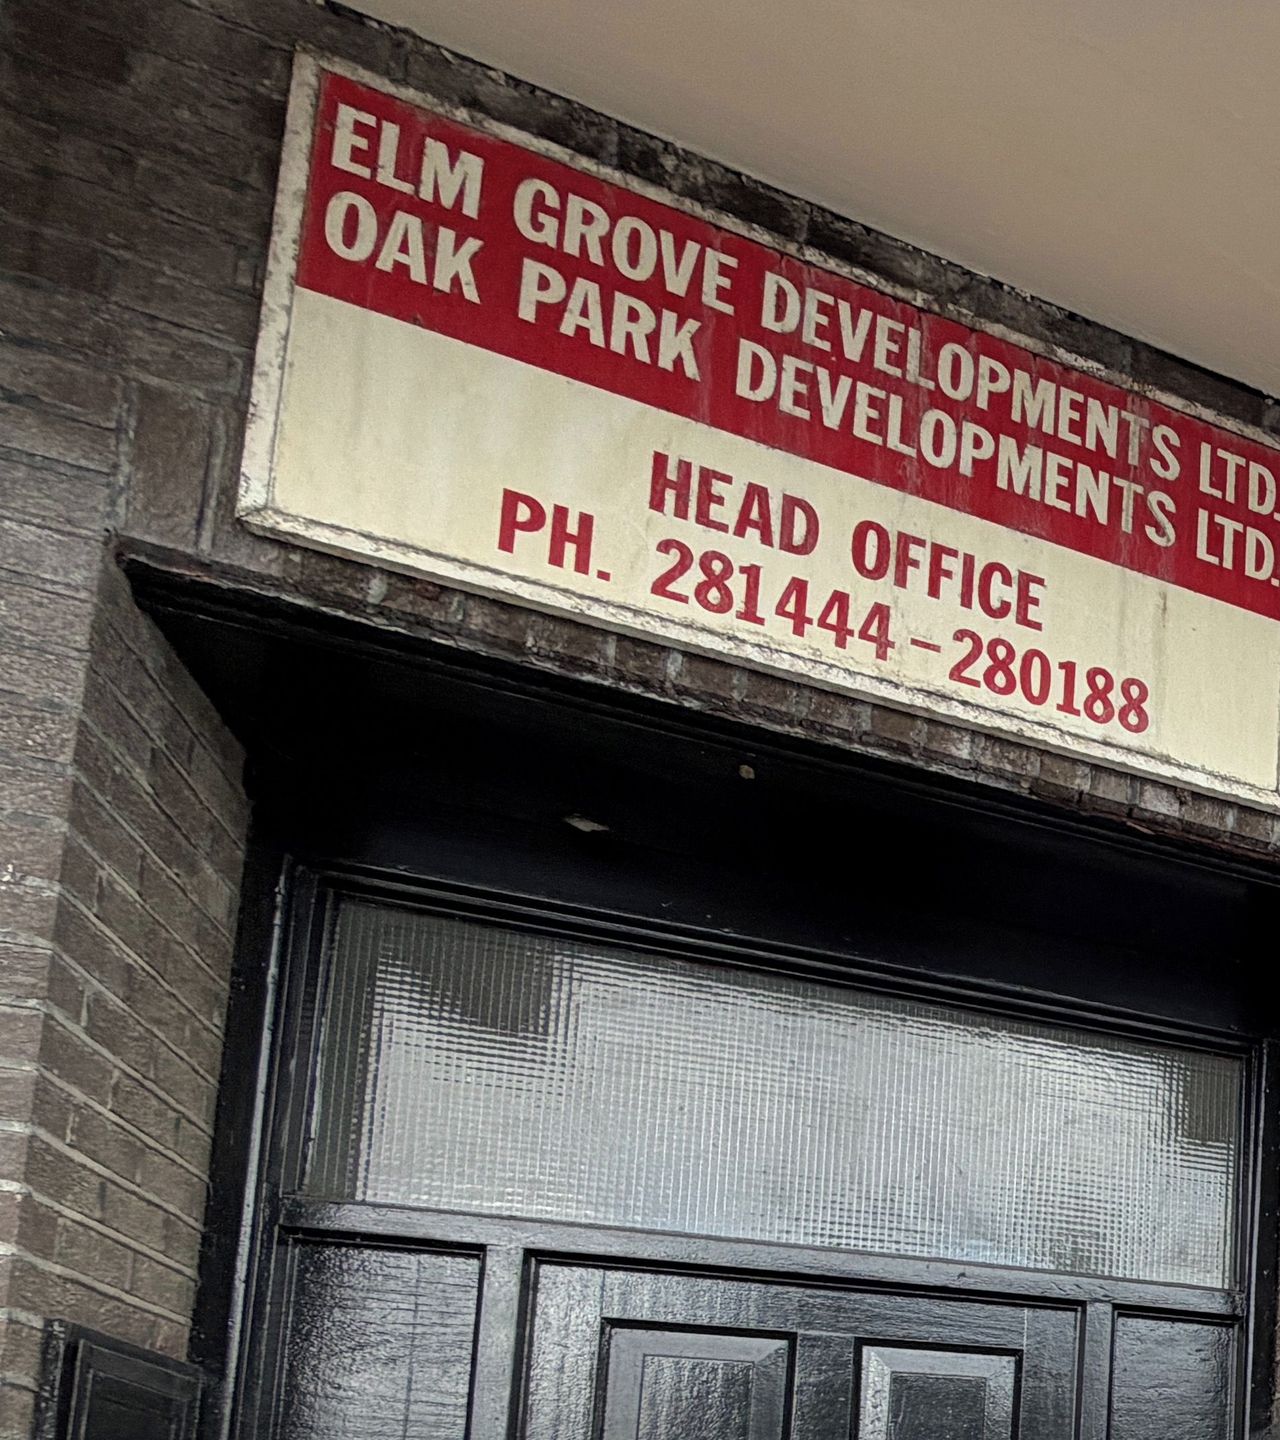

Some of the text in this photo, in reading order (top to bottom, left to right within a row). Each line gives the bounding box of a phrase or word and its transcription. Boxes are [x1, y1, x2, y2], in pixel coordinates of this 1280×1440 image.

[325, 191, 1280, 586] OAK PARK DEVELOPMENTS LTD.
[331, 103, 484, 219] ELM
[513, 178, 740, 316] GROVE
[761, 271, 1181, 481] DEVELOPMENTS
[497, 487, 612, 583] PH.
[648, 451, 1046, 632] HEAD OFFICE
